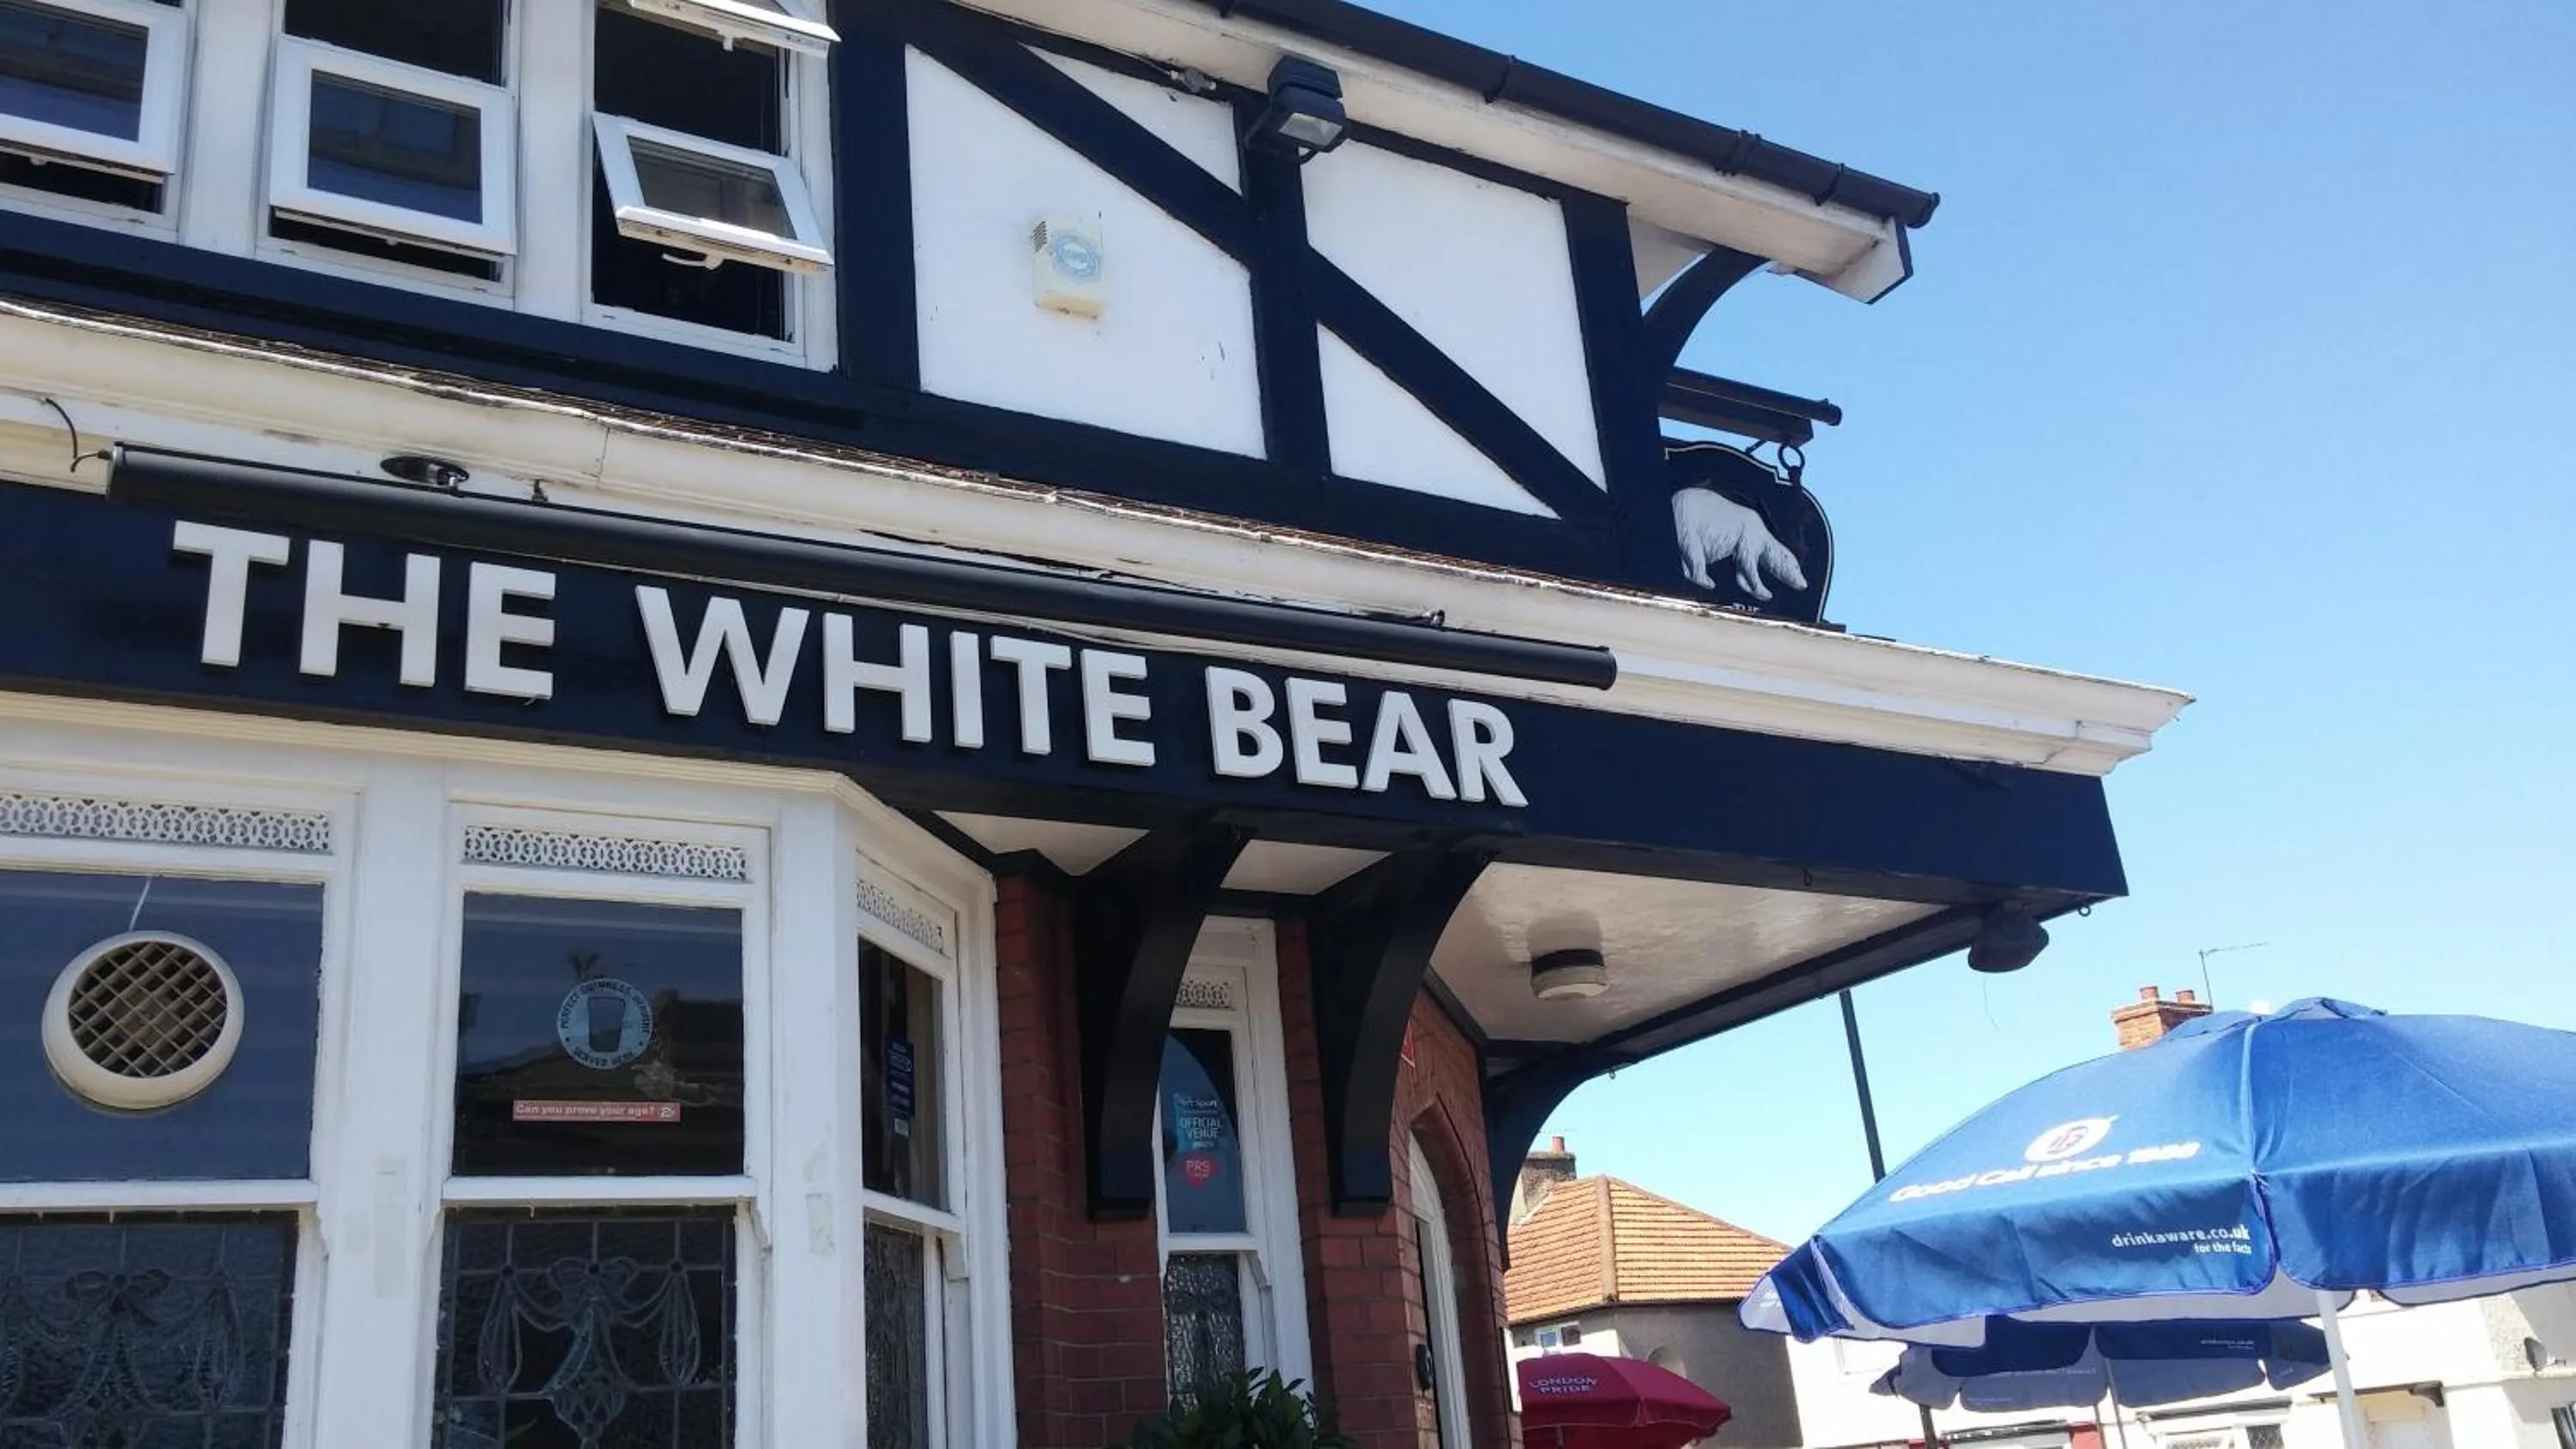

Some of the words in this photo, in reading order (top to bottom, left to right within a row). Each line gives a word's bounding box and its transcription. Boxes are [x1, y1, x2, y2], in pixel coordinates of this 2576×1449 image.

[173, 520, 556, 699] THE
[635, 585, 1155, 767] WHITE
[1206, 665, 1528, 808] BEAR
[515, 1104, 538, 1114] Can
[541, 1106, 562, 1117] you
[564, 1106, 599, 1117] prove
[600, 1106, 627, 1117] your
[628, 1106, 655, 1118] age?
[1180, 1118, 1223, 1128] OFFICIAL
[1188, 1127, 1219, 1140] VENUE
[1186, 1160, 1210, 1172] PRS
[1889, 1173, 1978, 1202] Good
[2111, 1223, 2251, 1247] drinkaware.co.uk
[2194, 1242, 2210, 1254] for
[2212, 1241, 2232, 1253] the
[2233, 1242, 2252, 1255] facts
[1528, 1377, 1598, 1388] LONDON
[1540, 1385, 1589, 1394] PRIDE
